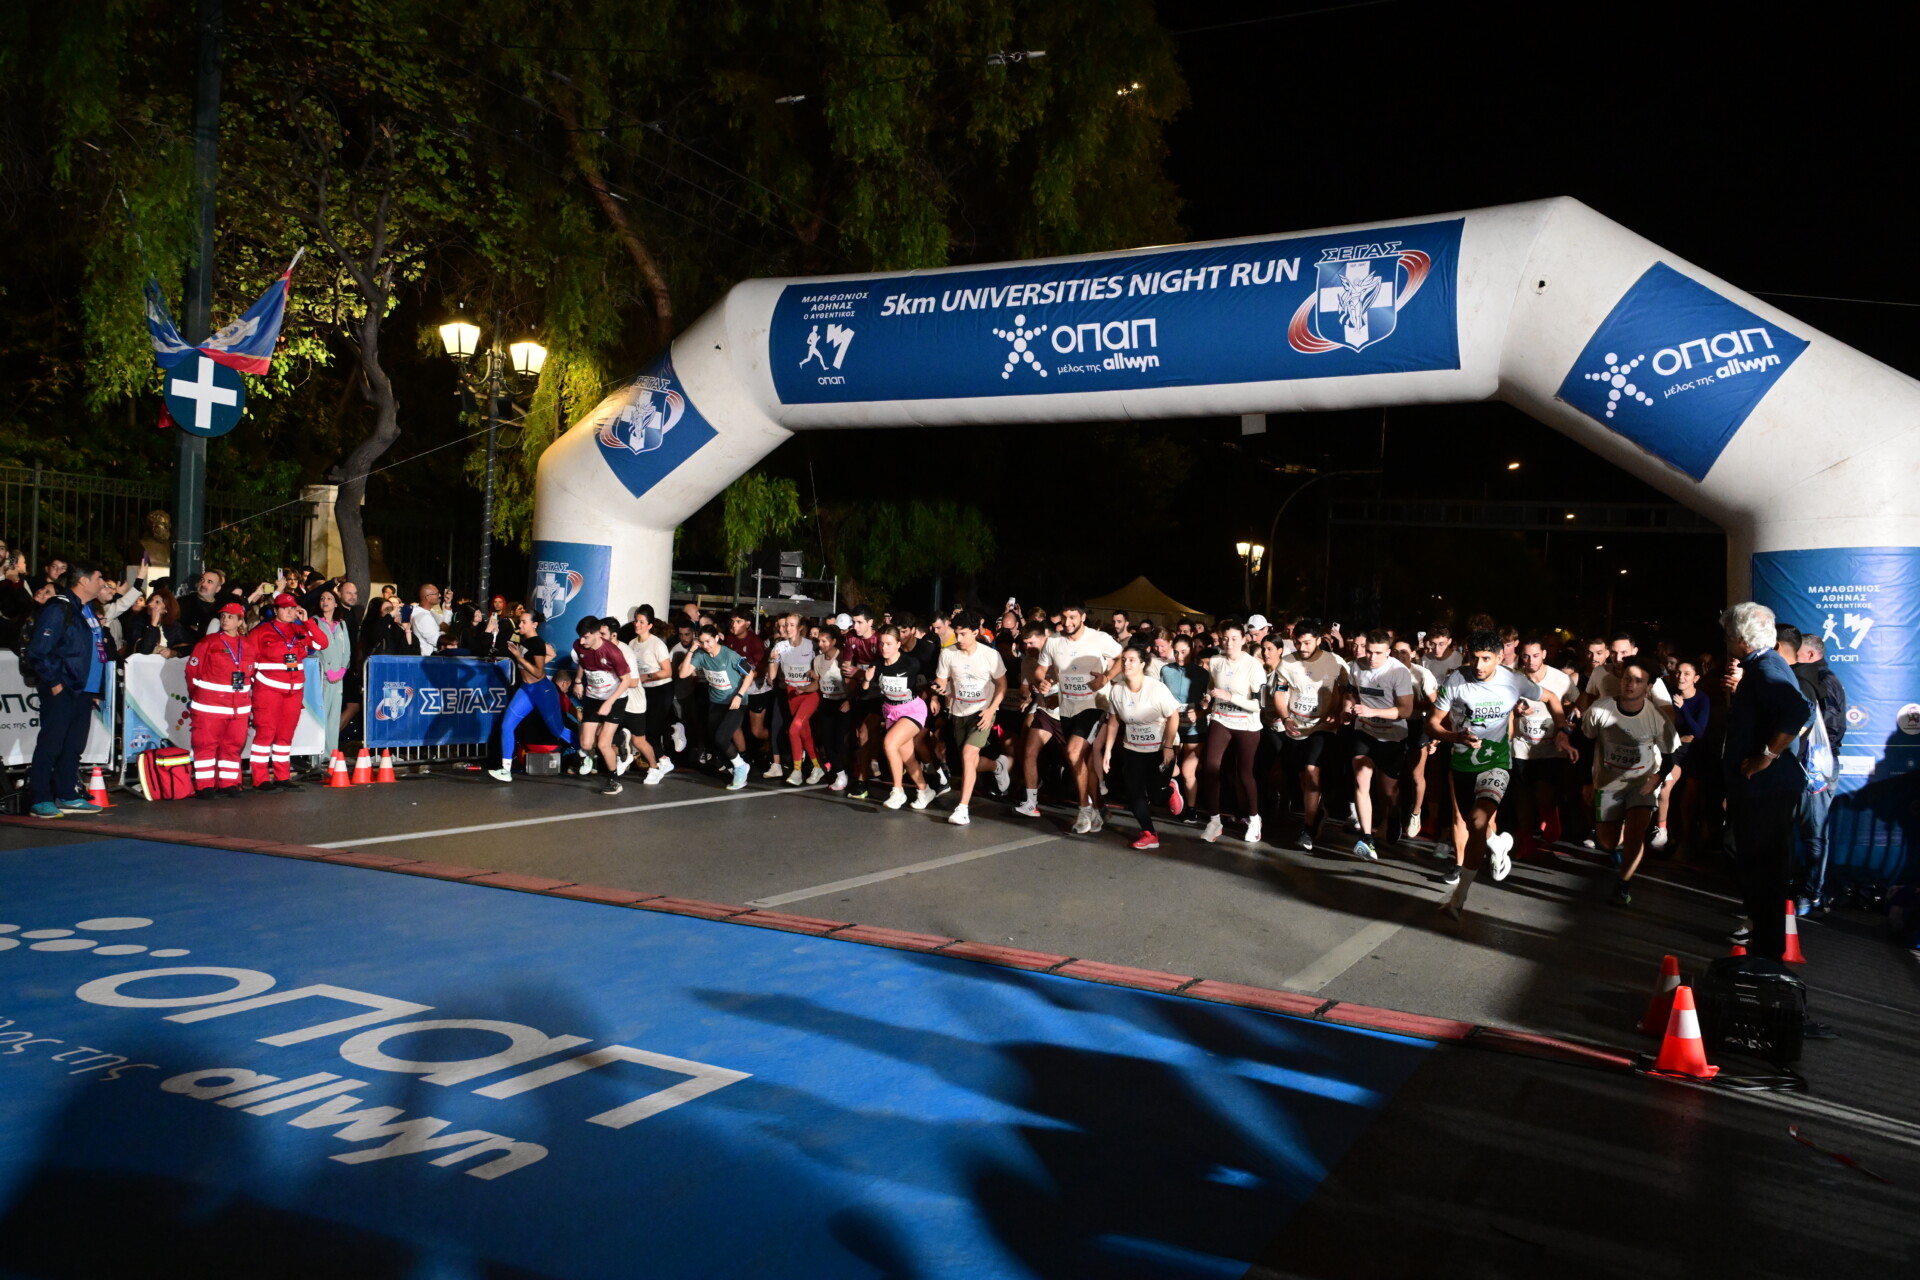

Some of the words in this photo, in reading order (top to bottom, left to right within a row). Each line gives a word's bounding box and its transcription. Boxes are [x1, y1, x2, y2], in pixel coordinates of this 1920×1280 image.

[1319, 241, 1402, 262] ΣΕΓΑΣ
[880, 293, 937, 316] 5km
[941, 275, 1124, 312] UNIVERSITIES
[1128, 265, 1227, 297] NIGHT
[1230, 257, 1301, 287] RUN
[801, 292, 869, 303] ΜΑΡΑΘΩΝΙΟΣ
[810, 302, 853, 311] ΑΘΗΝΑΣ
[810, 311, 855, 320] ΑΥΘΕΝΤΙΚΟΣ
[1057, 364, 1085, 375] μέλος
[1086, 364, 1101, 372] της
[1103, 353, 1160, 373] allwyn
[1664, 381, 1695, 399] μέλος
[1695, 375, 1715, 386] της
[1716, 354, 1781, 379] allwyn
[537, 561, 569, 572] ΣΕΓΑΣ
[1808, 585, 1881, 594] ΜΑΡΑΘΩΝΙΟΣ
[1821, 594, 1867, 602] ΑΘΗΝΑΣ
[1064, 683, 1087, 691] 97585
[419, 688, 507, 715] ΣΕΓΑΣ
[1475, 707, 1500, 715] ROAD
[1131, 733, 1156, 741] 97529
[160, 1067, 549, 1180] allwyn
